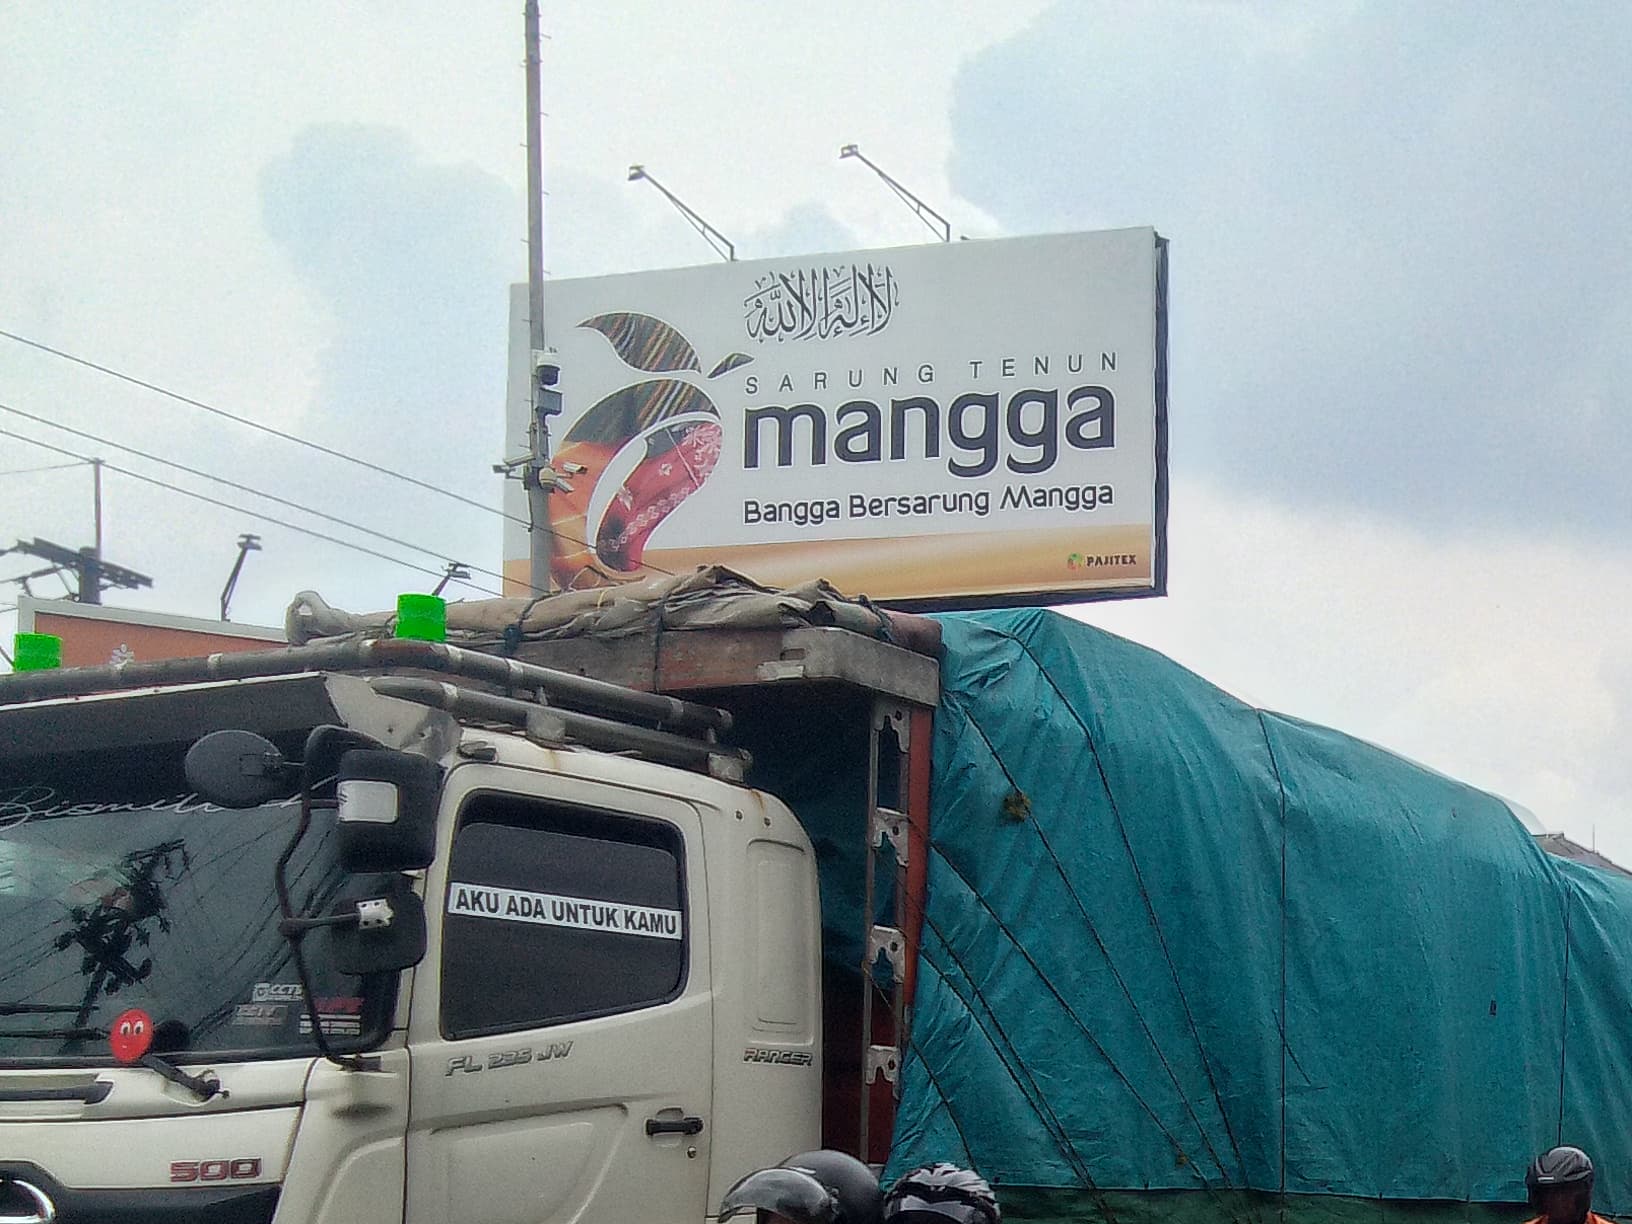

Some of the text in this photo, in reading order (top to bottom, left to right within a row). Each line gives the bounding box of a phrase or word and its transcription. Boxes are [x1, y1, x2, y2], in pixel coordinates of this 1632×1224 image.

[745, 351, 1118, 395] SARUNG TENUN
[743, 386, 1116, 479] mangga
[744, 485, 1115, 526] Bangga Bersarung Mangga
[1086, 554, 1137, 567] PAJITEX
[456, 888, 677, 934] AKU ADA UNTUK KAMU
[445, 1056, 483, 1076] FL
[537, 1041, 574, 1061] JW
[743, 1048, 813, 1067] RANGER
[170, 1159, 262, 1182] 500
